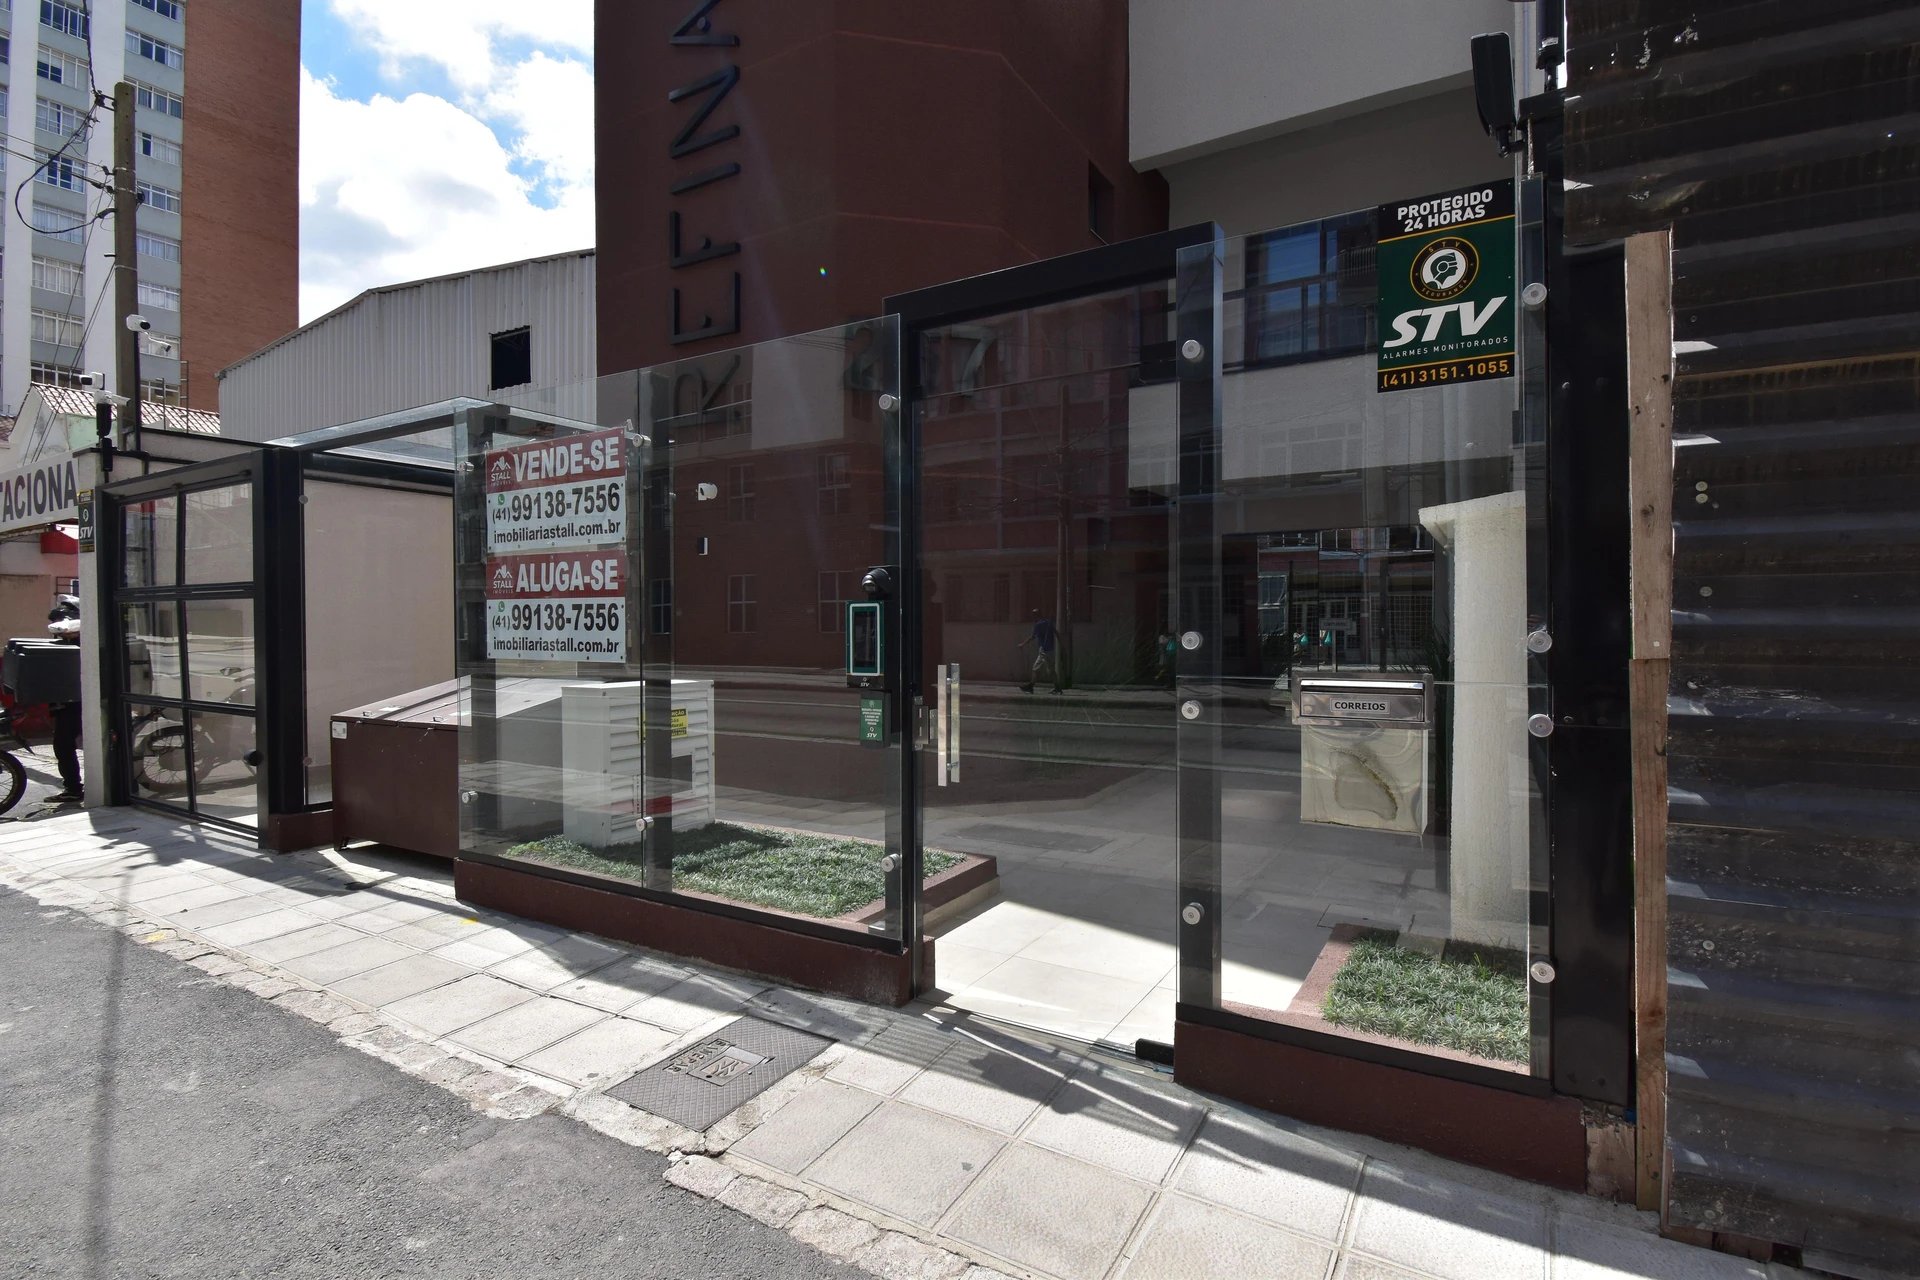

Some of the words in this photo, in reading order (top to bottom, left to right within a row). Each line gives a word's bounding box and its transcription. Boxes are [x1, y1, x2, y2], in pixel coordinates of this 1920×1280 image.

[1397, 189, 1493, 220] PROTEGIDO
[1404, 219, 1424, 232] 24
[1428, 204, 1486, 228] HORAS
[1383, 296, 1508, 348] STV
[1383, 347, 1428, 360] ALARMES
[1433, 336, 1509, 352] MONITORADOS
[514, 436, 620, 482] VENDE-SE
[491, 471, 511, 481] STALL
[492, 507, 511, 524] (41)
[511, 483, 620, 522] 99138-7556
[79, 526, 93, 539] STV
[494, 519, 621, 544] imobiliariastall.com.br
[493, 580, 513, 589] STALL
[516, 559, 619, 593] ALUGA-SE
[492, 615, 511, 631] (41)
[511, 603, 619, 631] 99138-7556
[493, 637, 619, 653] imobiliariastall.com.br
[1334, 701, 1386, 711] CORREIOS
